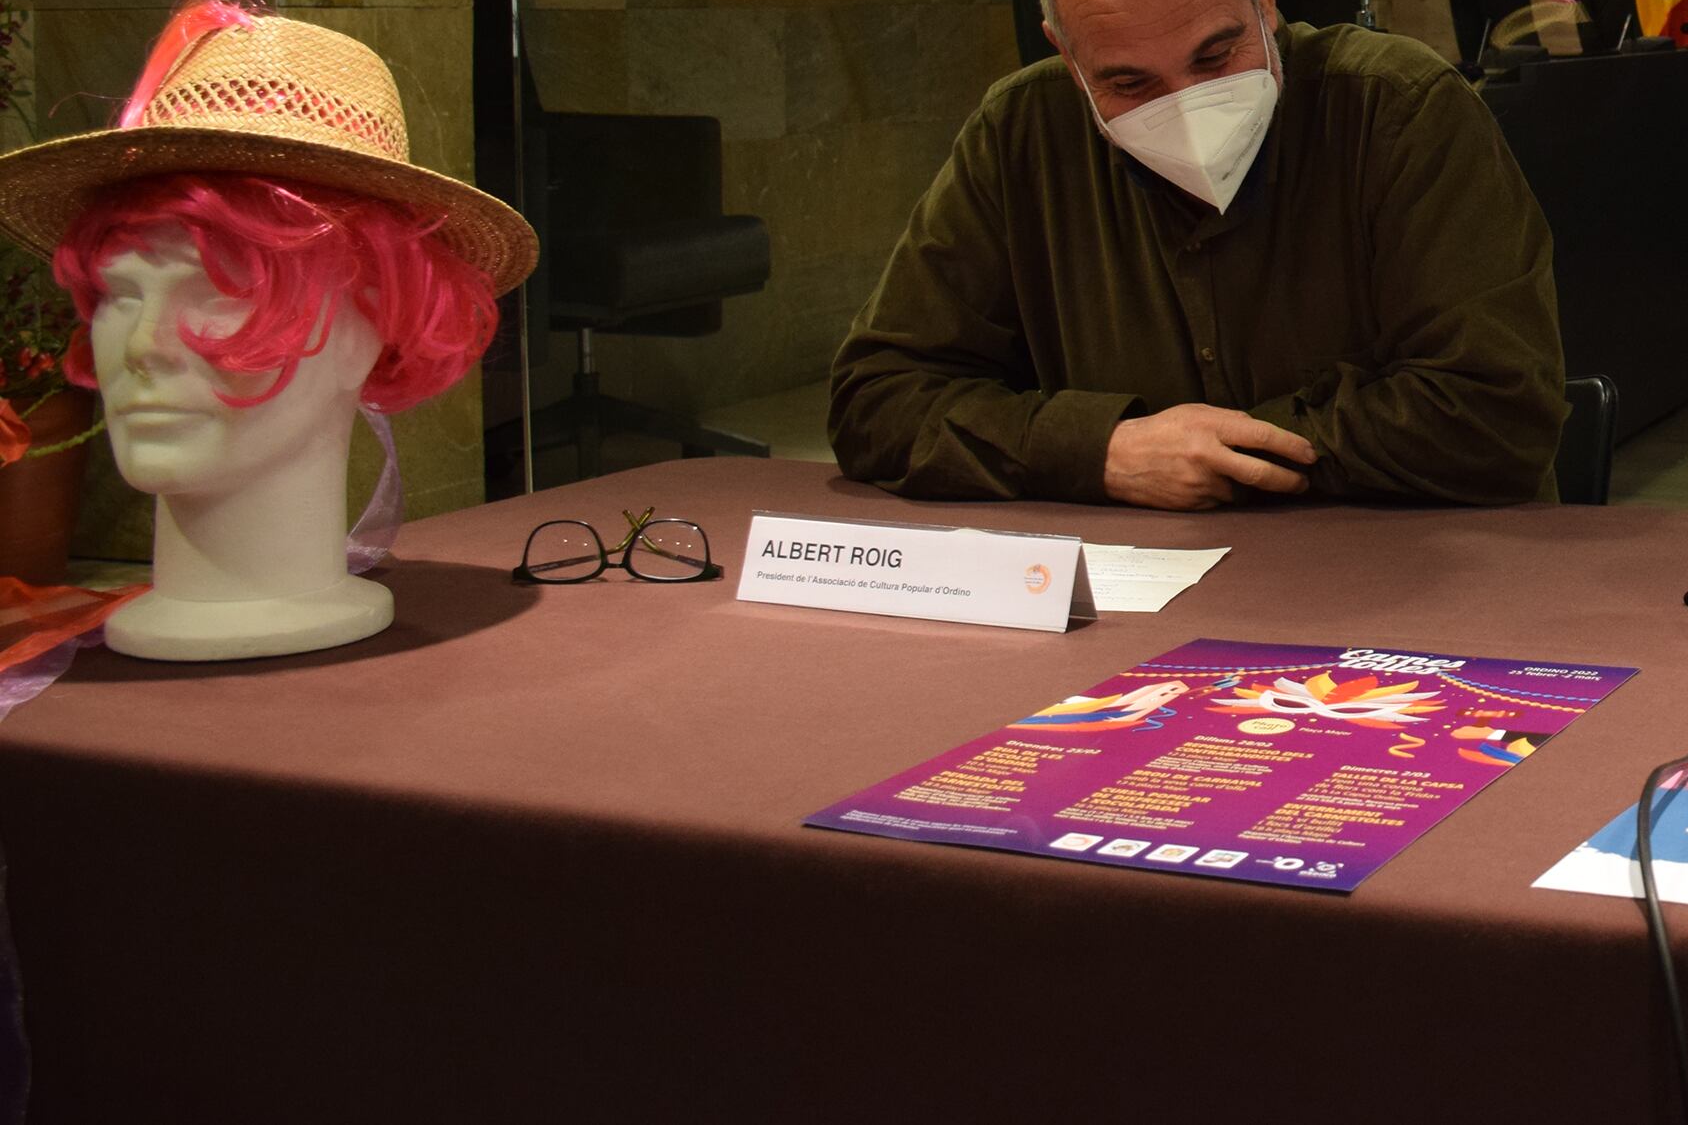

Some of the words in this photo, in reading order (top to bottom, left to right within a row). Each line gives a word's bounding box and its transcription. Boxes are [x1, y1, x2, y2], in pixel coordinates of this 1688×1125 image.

[762, 539, 846, 564] ALBERT
[850, 546, 903, 568] ROIG
[757, 571, 794, 583] President
[796, 573, 807, 583] de
[808, 575, 856, 588] l'Associació
[858, 579, 868, 589] de
[869, 580, 900, 591] Cultura
[901, 583, 933, 595] Popular
[934, 585, 971, 597] d'Ordino
[1339, 649, 1466, 668] Carnes
[1299, 727, 1325, 735] Plaça
[1194, 735, 1235, 744] Dilluns
[1006, 740, 1064, 752] Divendres
[1340, 765, 1398, 775] Dimecres
[1193, 776, 1263, 787] CARNAVAL
[1332, 773, 1378, 783] TALLER
[1400, 779, 1418, 787] LA
[1420, 781, 1464, 789] CAPSA
[1334, 783, 1360, 792] flors
[1382, 783, 1424, 792] corona
[1148, 792, 1212, 803] POPULAR
[1283, 803, 1384, 817] ENTERRAMENT
[1304, 811, 1406, 827] CARNESTOLTES
[1310, 819, 1344, 827] bullit
